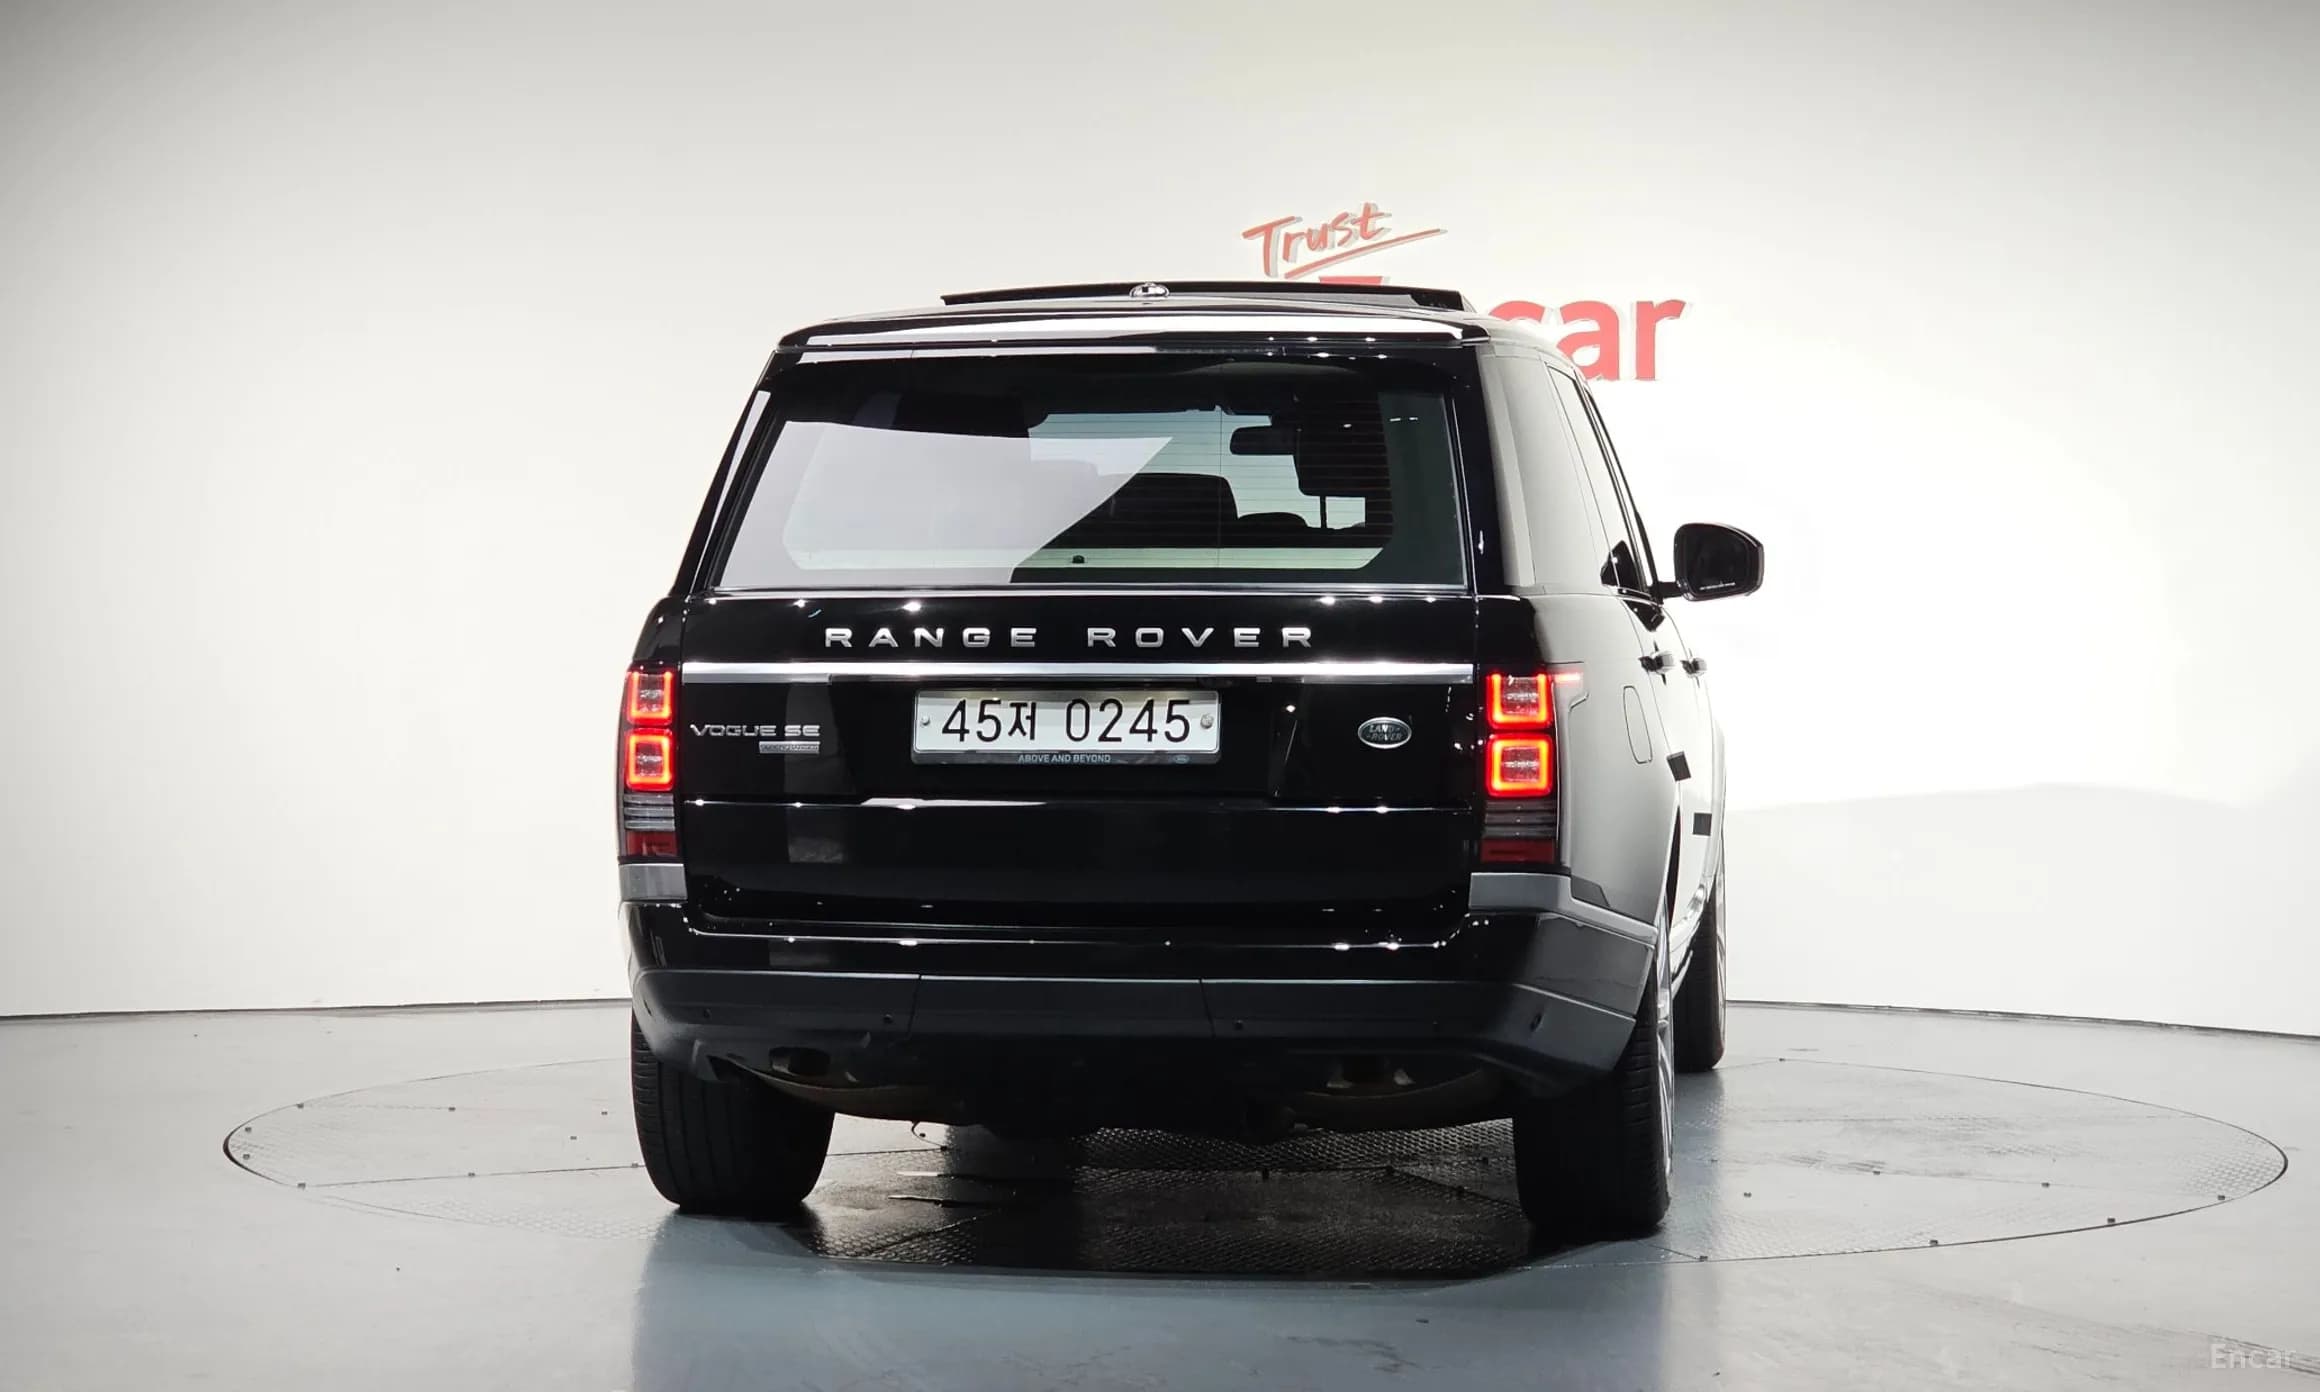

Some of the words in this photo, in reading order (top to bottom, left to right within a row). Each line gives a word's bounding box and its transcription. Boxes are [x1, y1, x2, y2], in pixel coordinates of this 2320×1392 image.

[1242, 201, 1392, 278] Trust
[824, 627, 1038, 648] RANGE
[1087, 627, 1313, 648] ROVER
[690, 724, 777, 737] VOGUE
[784, 724, 820, 737] SE
[941, 698, 1037, 743] 45저
[1065, 698, 1191, 743] 0245
[1018, 754, 1050, 764] ABOVE
[1051, 754, 1072, 764] AND
[1073, 754, 1112, 764] BEYOND
